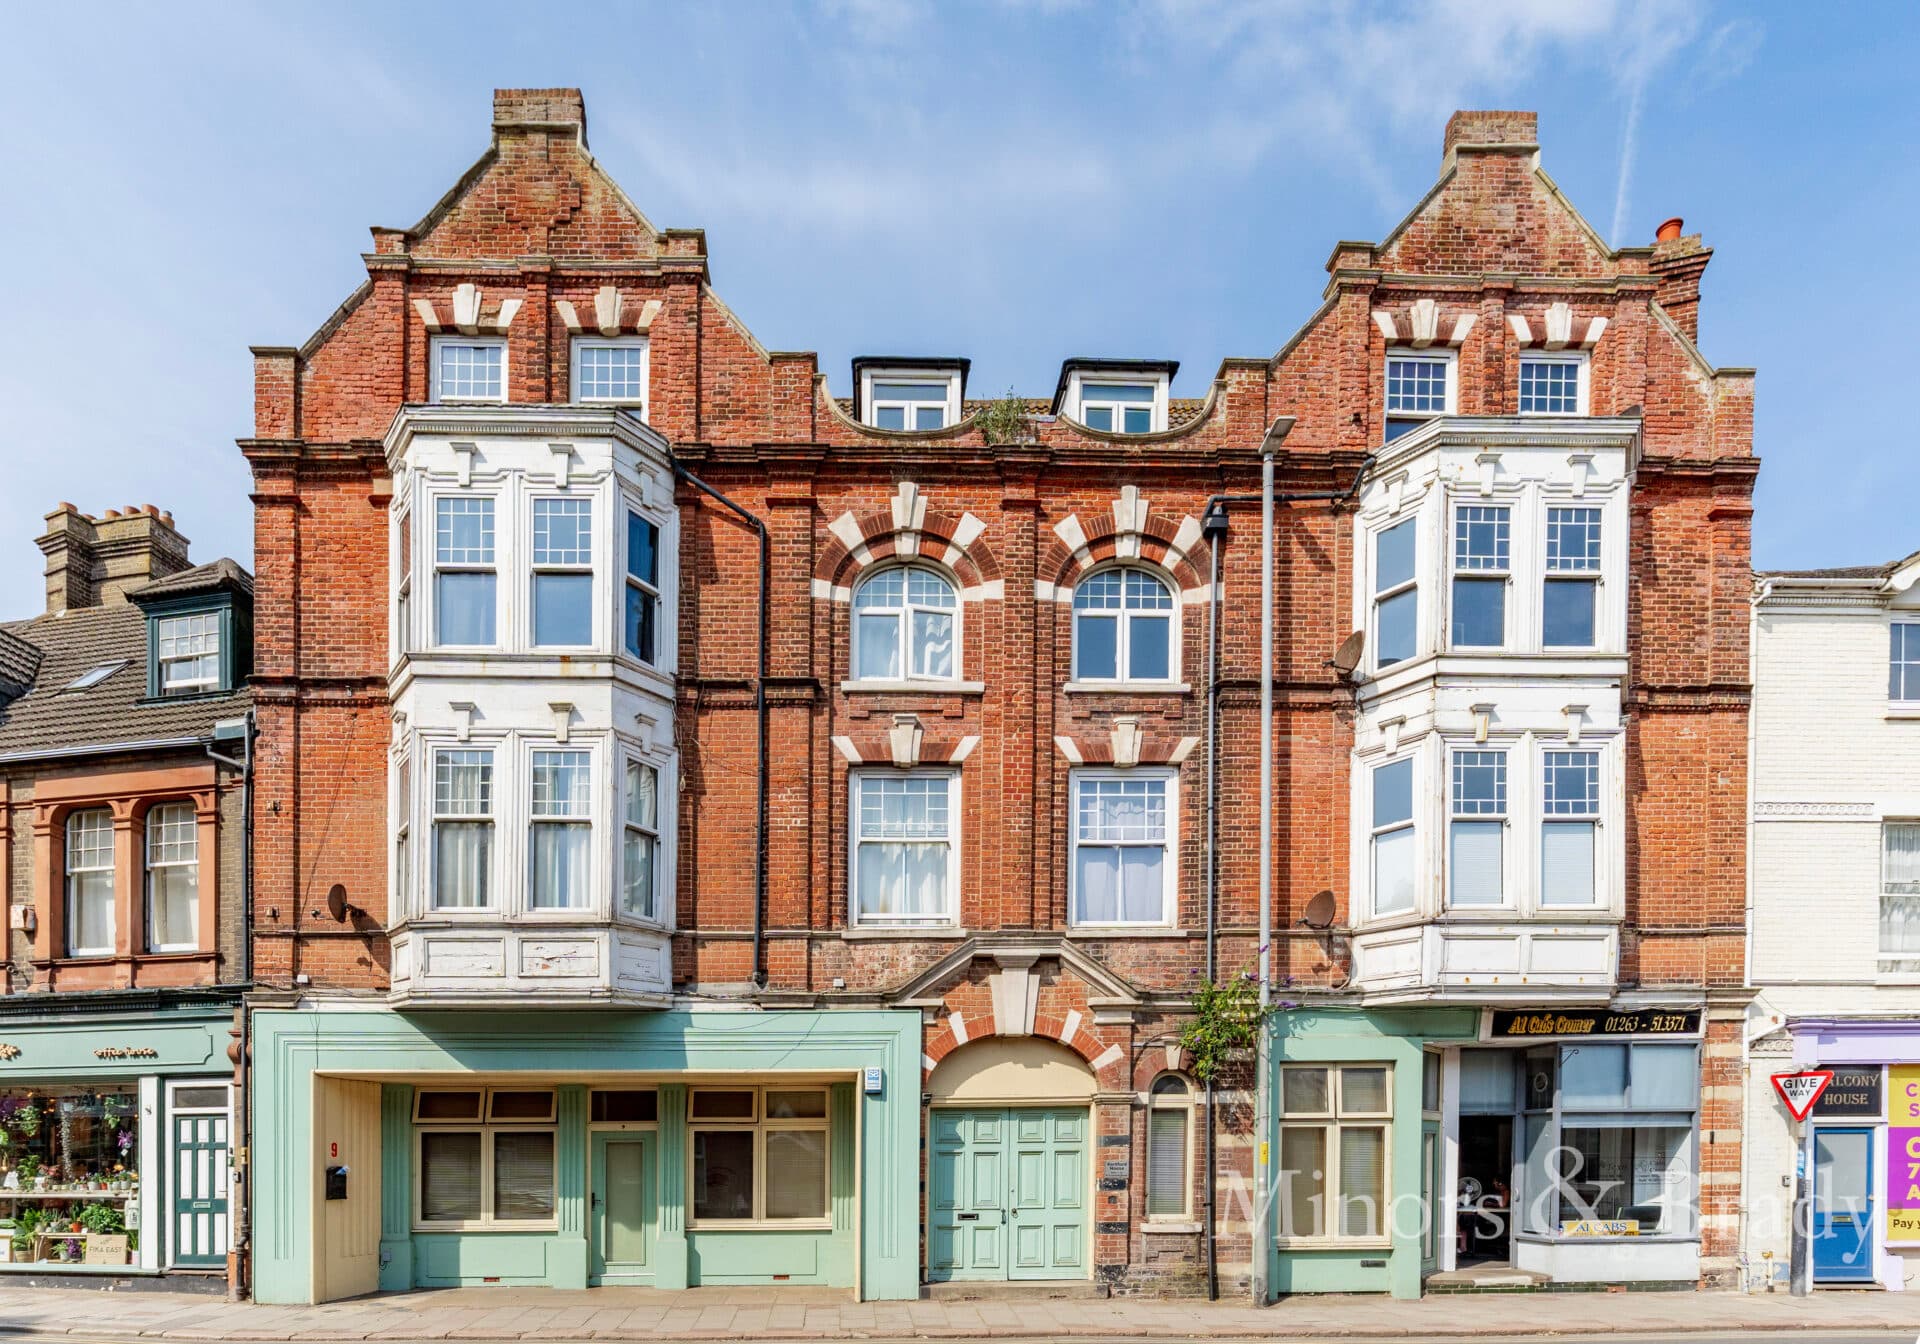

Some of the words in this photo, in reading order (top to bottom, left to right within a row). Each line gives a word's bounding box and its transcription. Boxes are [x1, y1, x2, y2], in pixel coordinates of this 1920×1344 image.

[1604, 1016, 1639, 1032] 01263
[1650, 1015, 1687, 1032] 513371
[1783, 1078, 1817, 1089] GIVE
[1829, 1073, 1880, 1087] LCONY
[1789, 1089, 1811, 1097] WAY
[1824, 1093, 1869, 1105] HOUSE
[331, 1142, 338, 1158] 9
[1594, 1222, 1628, 1232] CABS
[1893, 1219, 1914, 1230] Pay
